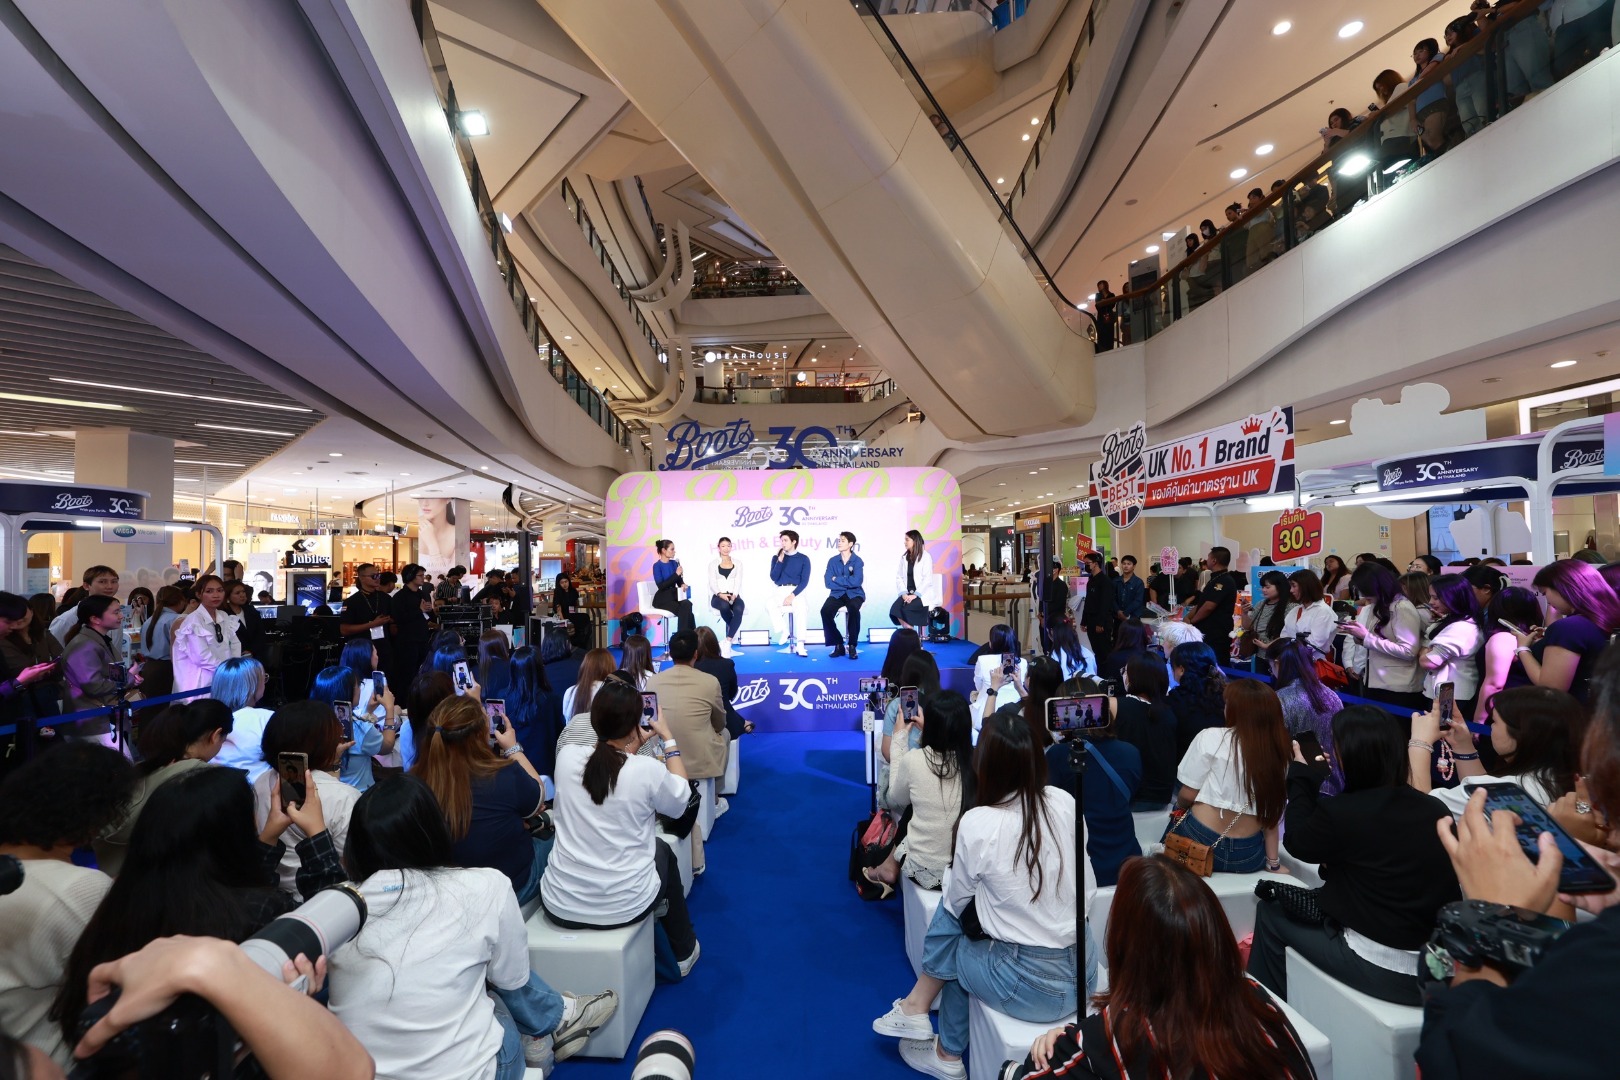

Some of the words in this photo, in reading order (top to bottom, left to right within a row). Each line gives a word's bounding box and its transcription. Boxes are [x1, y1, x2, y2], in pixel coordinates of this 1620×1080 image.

[717, 352, 788, 360] BEARHOUSE
[658, 418, 755, 471] Boots
[768, 425, 838, 469] 30
[836, 425, 853, 434] TH
[821, 447, 904, 458] ANNIVERSARY
[1097, 424, 1144, 479] Boots
[1148, 448, 1169, 478] UK
[1171, 444, 1195, 474] No.
[1198, 436, 1209, 467] 1
[1214, 426, 1271, 465] Brand
[834, 460, 880, 469] THAILAND
[1415, 462, 1445, 482] 30
[1437, 466, 1479, 475] ANNIVERSARY
[1242, 468, 1260, 486] UK
[1382, 467, 1403, 487] Boots
[1110, 476, 1136, 503] BEST
[51, 493, 93, 510] Boots
[109, 497, 130, 514] 30
[1109, 503, 1121, 514] FOR
[1122, 495, 1136, 509] LESS
[731, 505, 774, 528] Boots
[779, 506, 810, 526] 30
[710, 538, 755, 554] Halth
[759, 536, 769, 548] &
[773, 536, 822, 551] Buty
[1279, 526, 1319, 553] 30.-
[291, 553, 330, 566] Jubilee
[729, 677, 771, 710] oots
[779, 678, 828, 711] 30
[826, 677, 838, 685] TH
[824, 702, 858, 710] THAILAND
